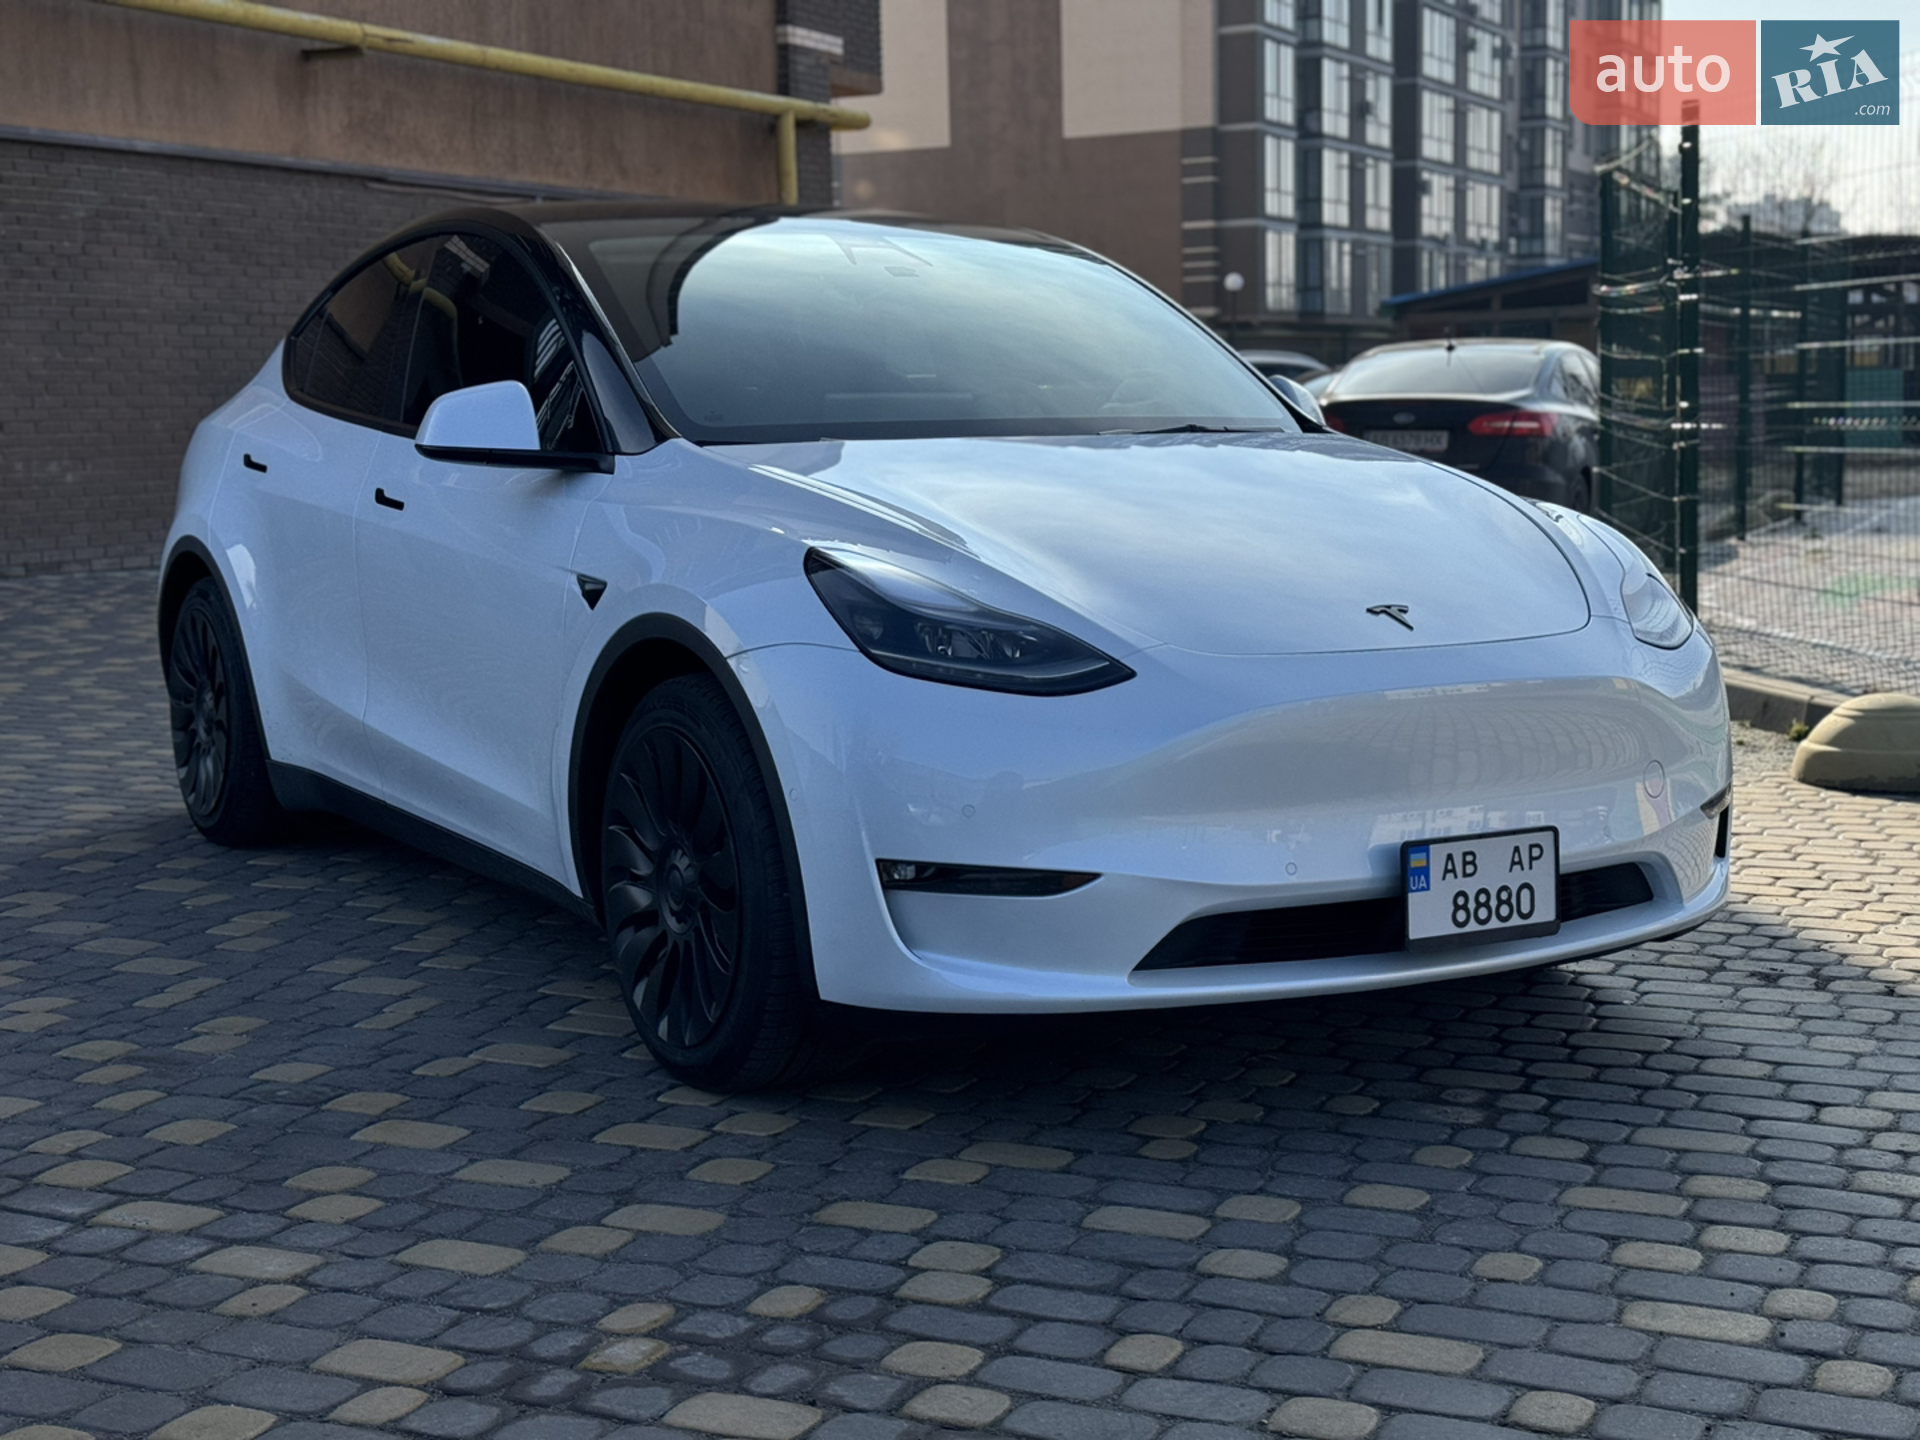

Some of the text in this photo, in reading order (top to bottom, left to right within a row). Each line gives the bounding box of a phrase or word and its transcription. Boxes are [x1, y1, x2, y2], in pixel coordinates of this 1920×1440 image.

[1441, 843, 1544, 881] AB AP
[1410, 874, 1428, 890] UA
[1451, 882, 1536, 928] 8880
